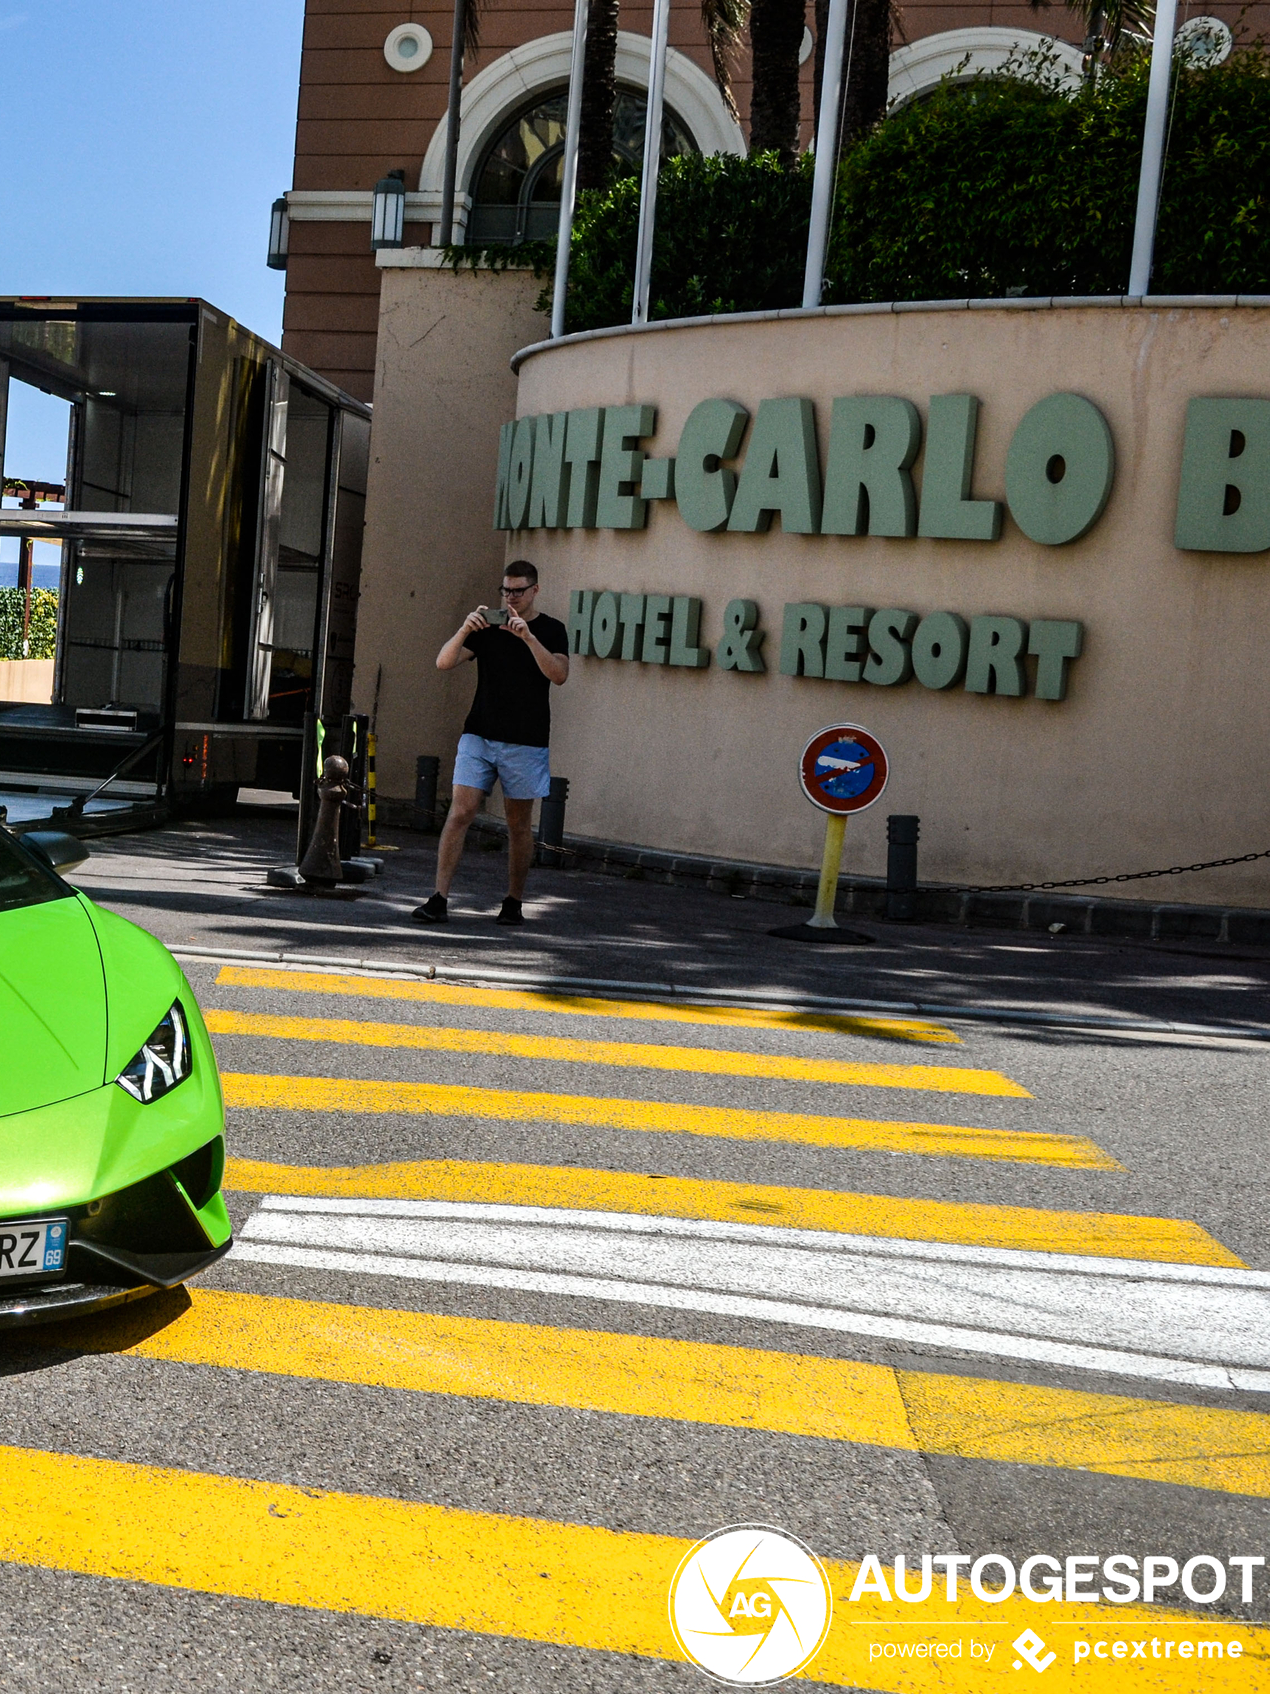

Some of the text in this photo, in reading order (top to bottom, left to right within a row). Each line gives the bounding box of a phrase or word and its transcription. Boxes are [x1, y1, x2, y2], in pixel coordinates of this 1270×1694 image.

[493, 392, 1114, 546] MONTE-CARLO
[569, 588, 1083, 701] HOTEL & RESORT
[45, 1249, 61, 1266] 69
